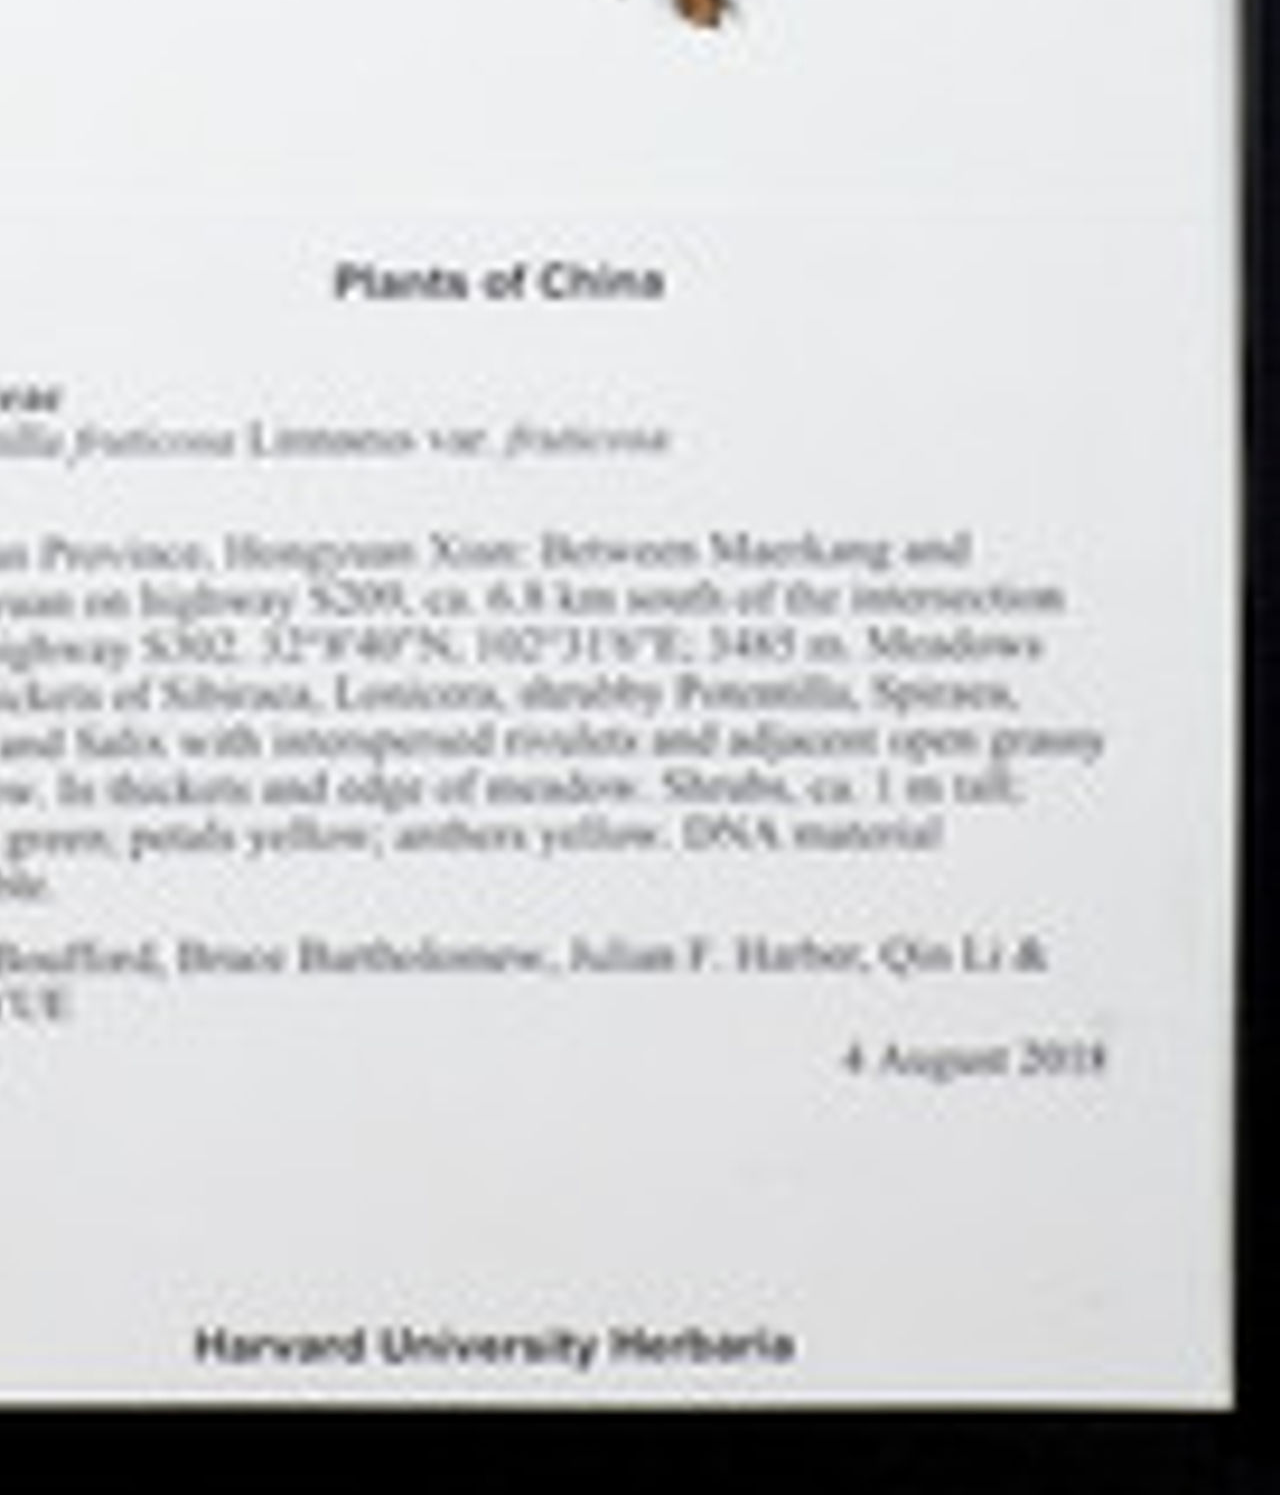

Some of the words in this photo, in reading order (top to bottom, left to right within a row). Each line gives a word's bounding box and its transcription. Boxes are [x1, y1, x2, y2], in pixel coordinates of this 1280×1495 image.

[335, 262, 467, 300] Plants
[485, 262, 524, 300] of
[540, 262, 664, 300] China
[225, 532, 416, 577] Hongyuan
[542, 532, 700, 570] Between
[709, 532, 892, 577] Maerkang
[904, 532, 972, 570] and
[84, 590, 129, 616] on
[140, 581, 292, 624] highway
[556, 581, 617, 616] km
[626, 581, 723, 616] south
[734, 581, 779, 616] of
[785, 581, 840, 616] the
[850, 581, 1066, 616] intersection
[867, 627, 1044, 663] Meadows
[112, 673, 152, 710] of
[518, 673, 663, 716] shrubby
[179, 722, 262, 759] with
[273, 722, 494, 766] interspersed
[505, 722, 637, 759] rivulets
[652, 722, 720, 759] and
[728, 722, 879, 766] adjacent
[888, 731, 979, 766] open
[990, 731, 1106, 766] grassy
[106, 768, 250, 805] thickets
[261, 768, 329, 805] and
[338, 768, 423, 812] edge
[431, 768, 477, 805] of
[904, 777, 945, 805] m
[130, 816, 237, 858] petals
[393, 816, 528, 851] anthers
[681, 816, 780, 851] DNA
[793, 816, 942, 851] material
[176, 937, 287, 973] Bruce
[568, 937, 675, 973] Julian
[878, 937, 954, 978] Qin
[961, 937, 1002, 973] Li
[1010, 937, 1049, 973] &
[879, 1042, 1008, 1082] August
[195, 1328, 365, 1363] Harvard
[380, 1328, 597, 1371] University
[608, 1328, 795, 1363] Herbaria
